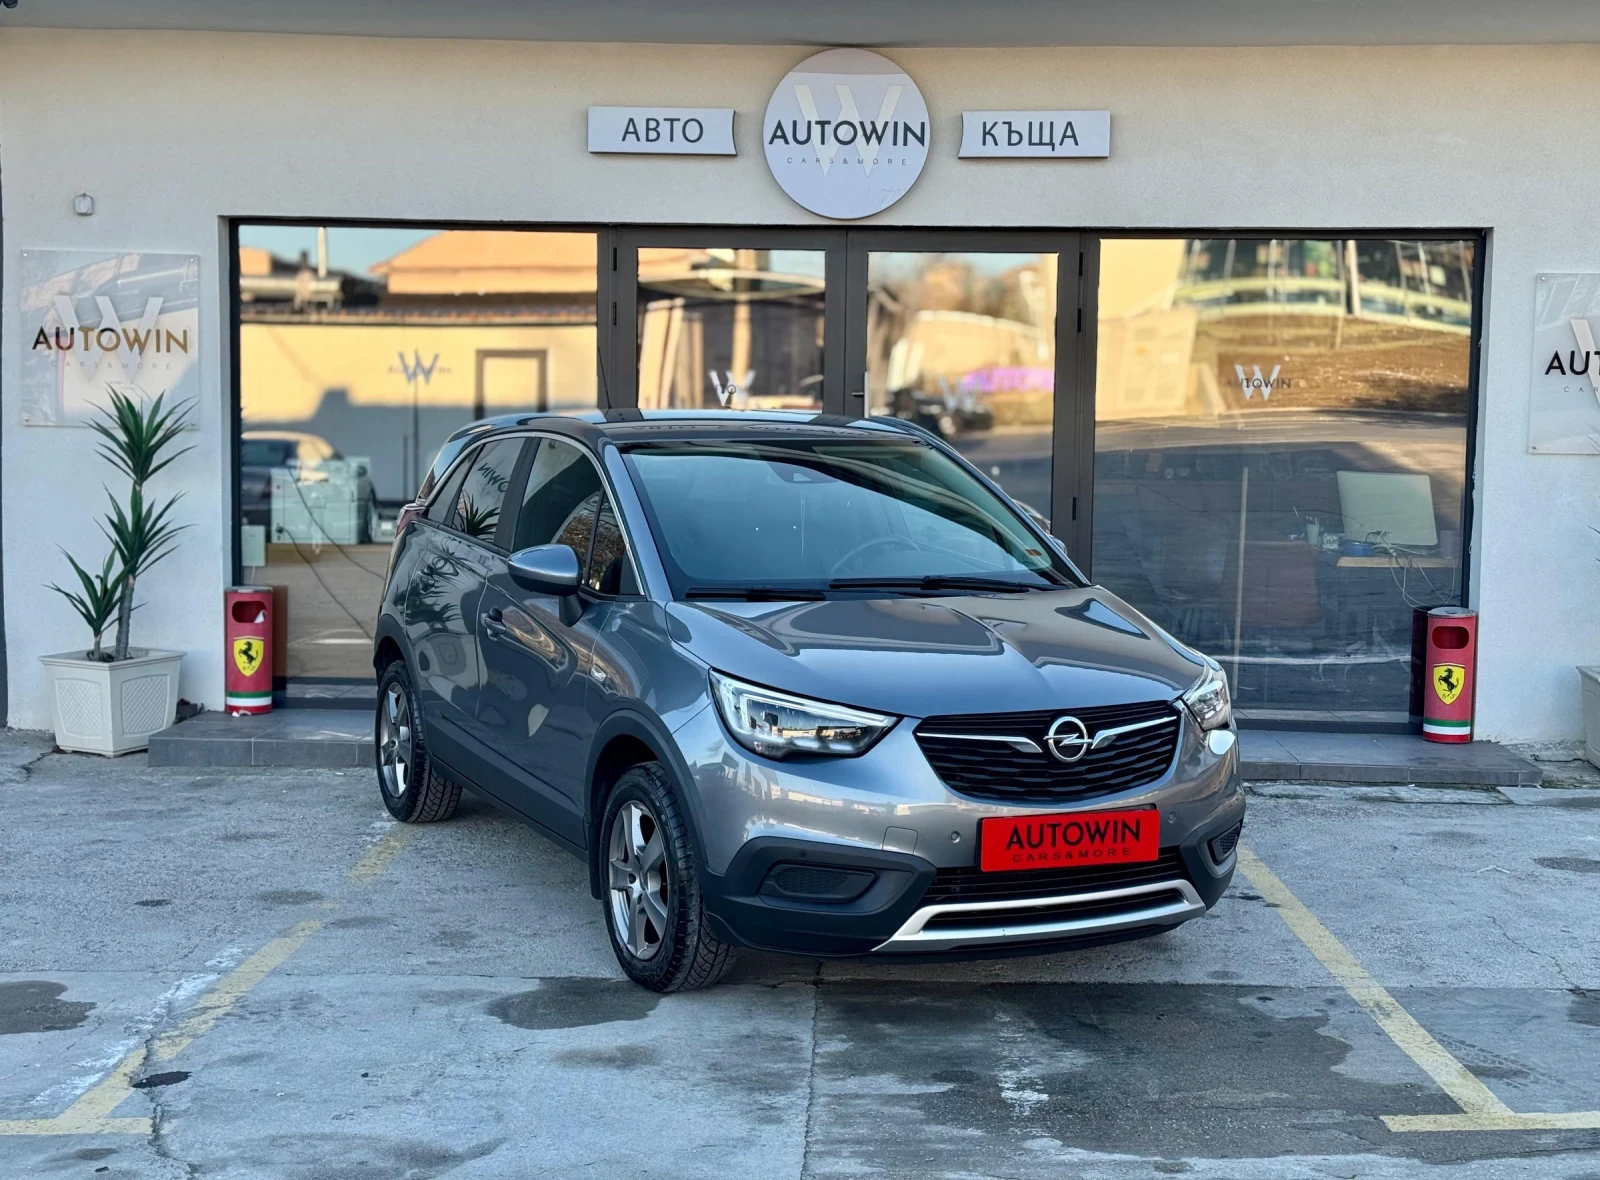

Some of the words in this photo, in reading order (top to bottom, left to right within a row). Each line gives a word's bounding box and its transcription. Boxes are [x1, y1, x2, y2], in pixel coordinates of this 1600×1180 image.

[621, 117, 704, 143] АВТО
[768, 119, 926, 147] AUTOWIN
[982, 121, 1079, 152] КЪЩА
[32, 325, 188, 354] AUTOWIN
[1006, 819, 1141, 851] AUTOWIN
[1012, 847, 1131, 863] CARS&MORE
